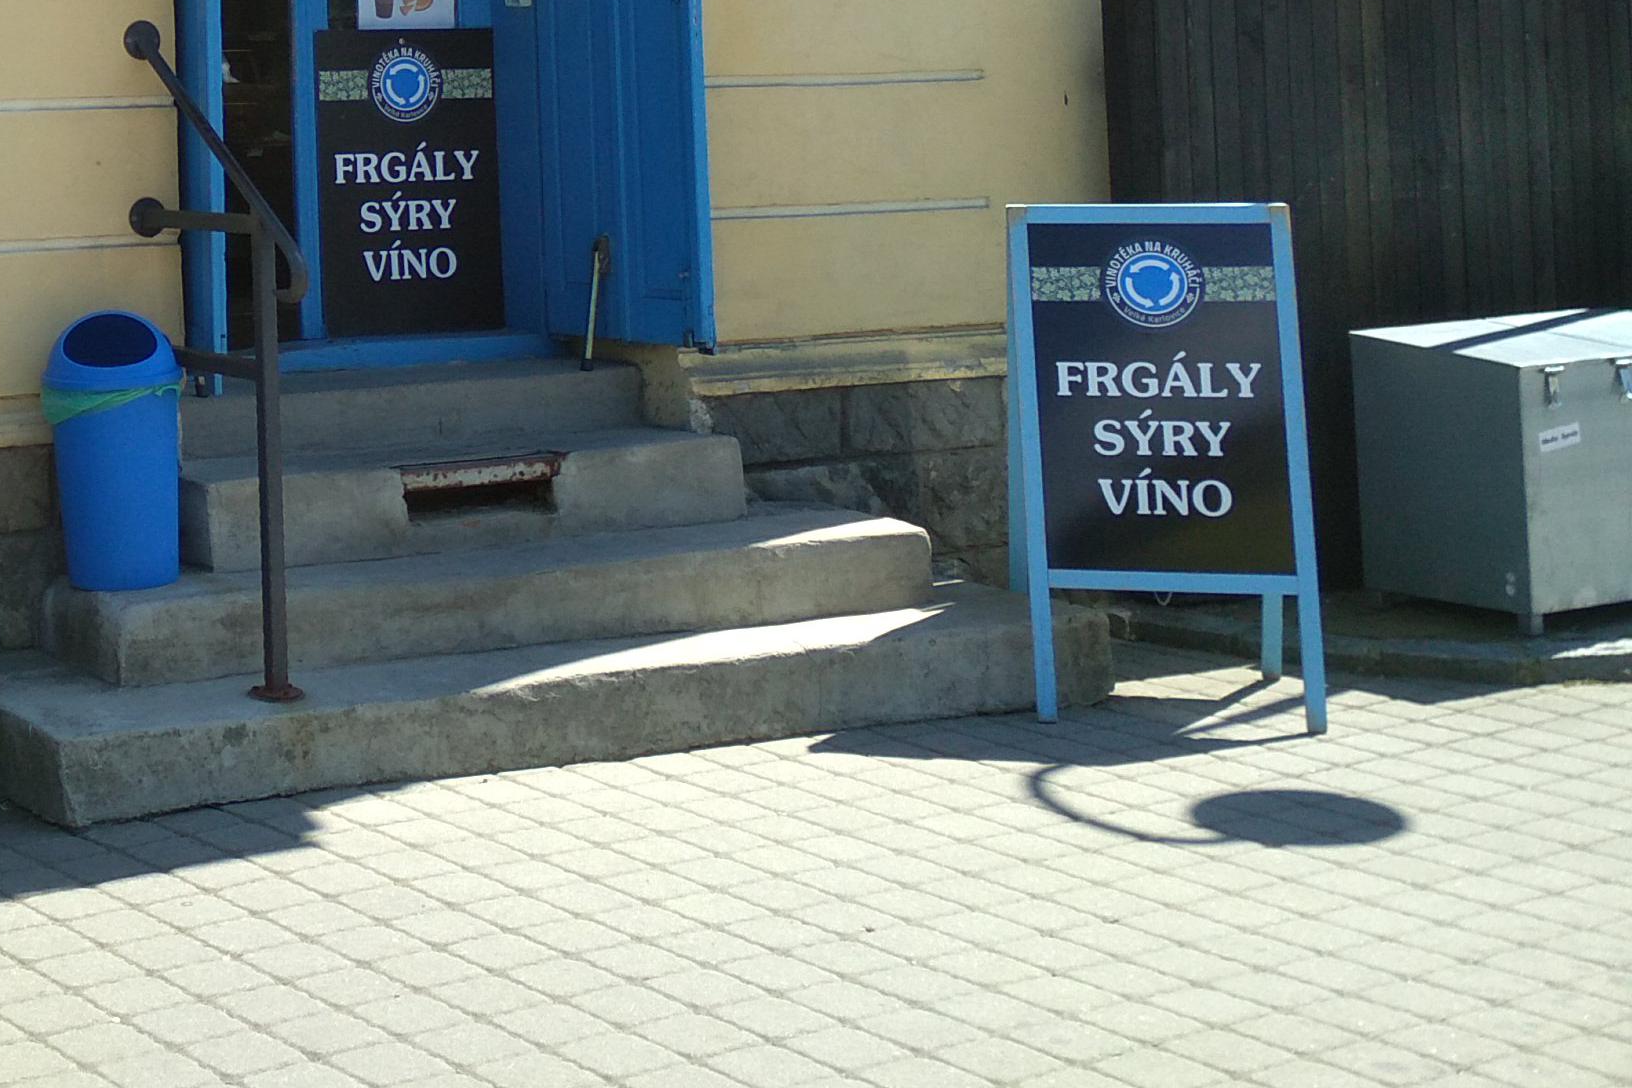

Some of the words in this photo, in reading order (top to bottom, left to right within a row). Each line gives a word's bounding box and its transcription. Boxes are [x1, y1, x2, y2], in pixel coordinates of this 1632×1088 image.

[400, 47, 413, 57] NA
[334, 141, 479, 184] FRGÁLY
[360, 191, 456, 233] SÝRY
[363, 240, 457, 282] VÍNO
[1105, 242, 1143, 288] VINOTÉKA
[1144, 241, 1161, 253] NA
[1163, 244, 1203, 288] KRUHÁČI
[1056, 350, 1261, 398] FRGÁLY
[1094, 409, 1231, 456] SÝRY
[1098, 467, 1232, 517] VÍNO
